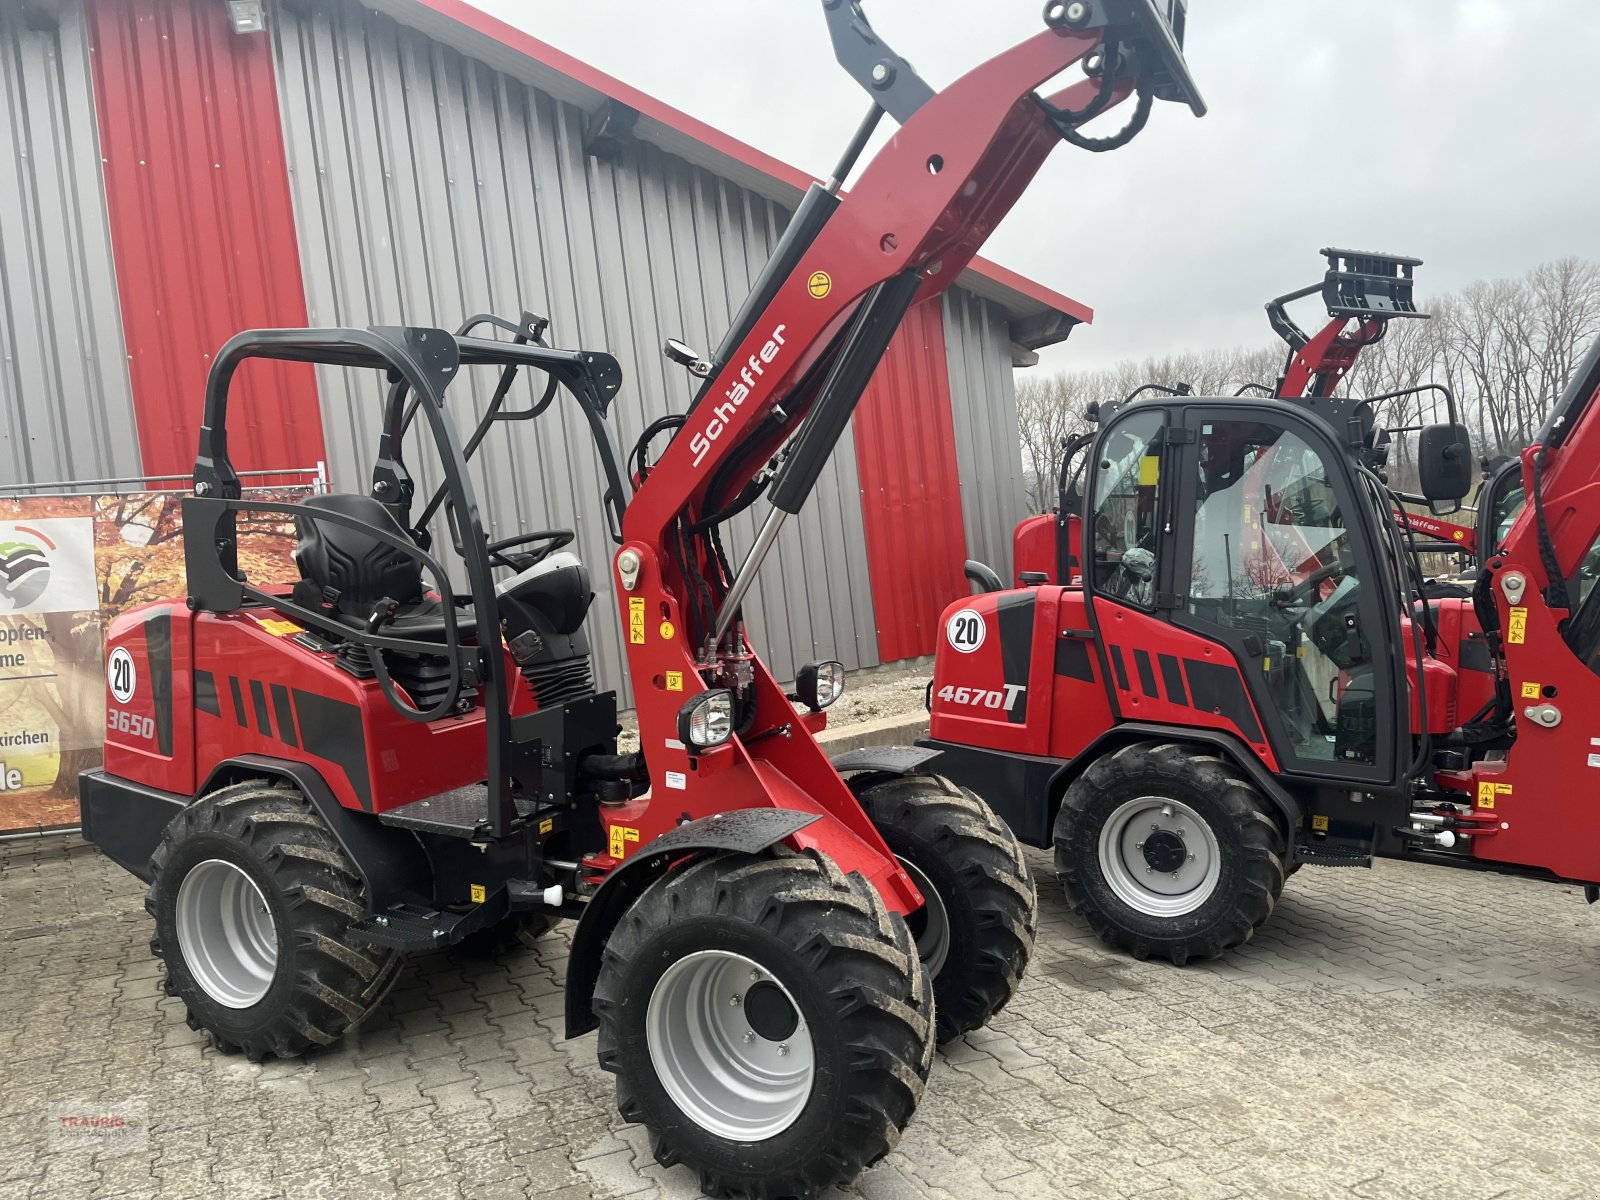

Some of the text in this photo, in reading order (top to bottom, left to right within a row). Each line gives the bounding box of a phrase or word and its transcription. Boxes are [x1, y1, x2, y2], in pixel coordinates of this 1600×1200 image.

[690, 325, 786, 467] Schäffer
[955, 617, 979, 645] 20
[114, 658, 130, 693] 20
[107, 709, 154, 739] 3650
